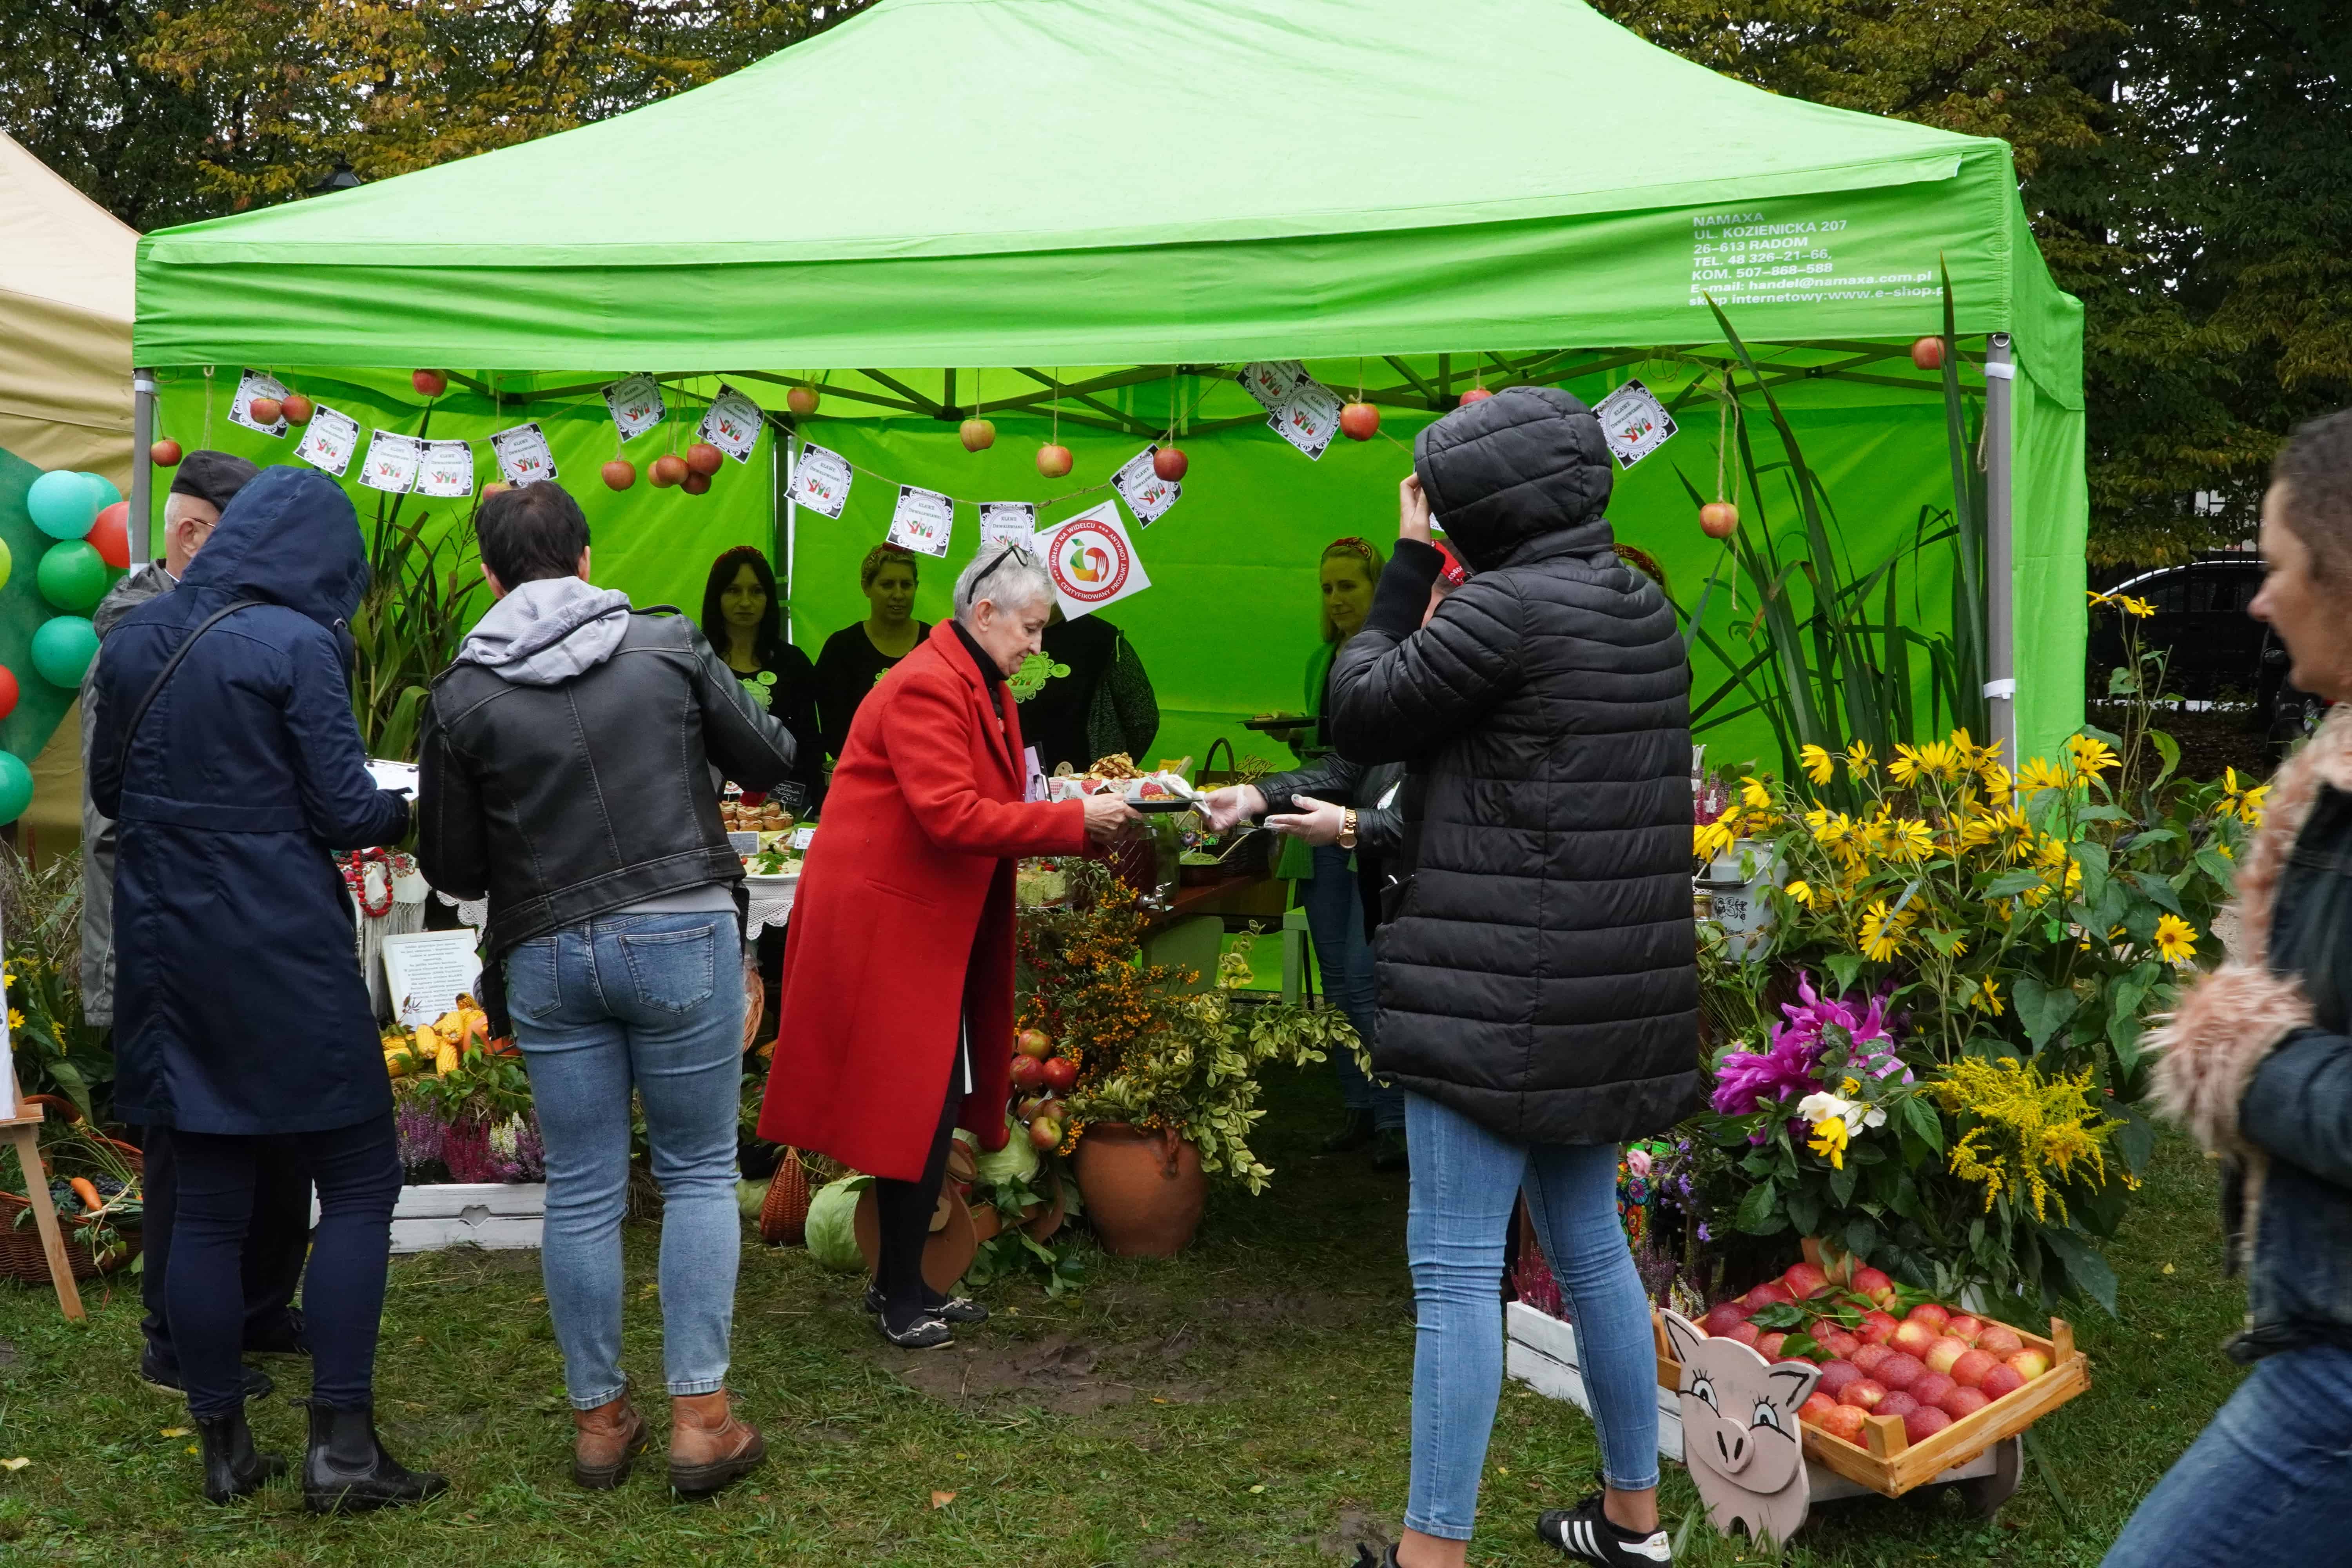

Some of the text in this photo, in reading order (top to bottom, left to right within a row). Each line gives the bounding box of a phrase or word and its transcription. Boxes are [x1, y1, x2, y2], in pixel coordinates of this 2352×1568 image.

[1693, 213, 1764, 226] NAMAXA
[1694, 220, 1847, 240] UL. KOZIENICKA 207
[1693, 237, 1808, 254] 26-613 RADOM
[1693, 249, 1831, 267] TEL. 48 326-21-66,
[1692, 263, 1833, 281] KOM. 507-868-588
[1690, 271, 1932, 294] E-mail: handel@namaxa.com.pl
[1310, 395, 1327, 409] KLAWE
[1613, 401, 1631, 416] KLAWE
[1132, 472, 1156, 491] DRWALEWIA
[1134, 466, 1150, 480] KLAWE
[1051, 522, 1096, 566] JABŁKO NA WIDELCU
[1060, 534, 1126, 599] CERTYFIKOWANY PRODUKT LOKALNY
